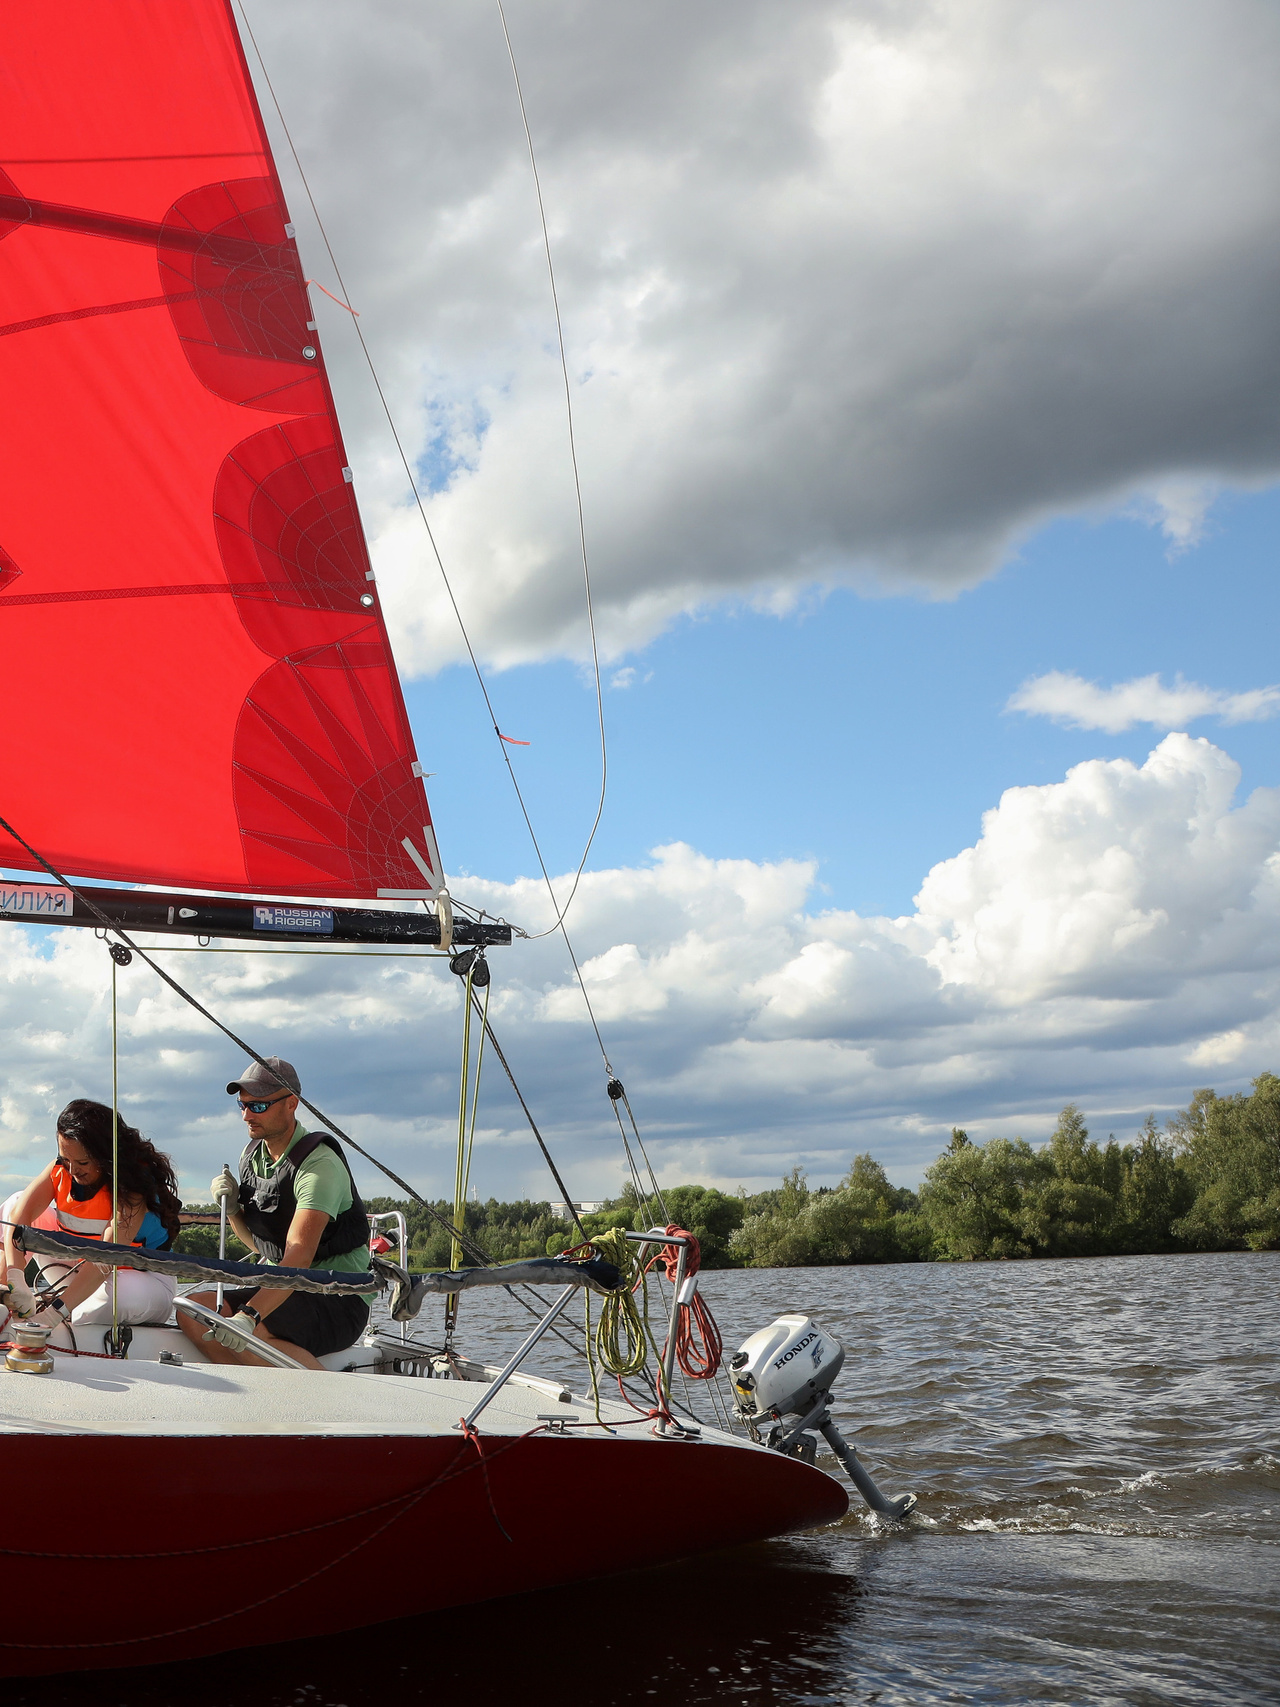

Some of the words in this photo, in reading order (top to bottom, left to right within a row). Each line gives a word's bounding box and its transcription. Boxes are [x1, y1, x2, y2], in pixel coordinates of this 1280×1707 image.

[274, 908, 331, 918] RUSSIAN
[274, 917, 321, 926] RIGGER
[773, 1332, 819, 1370] HONDA
